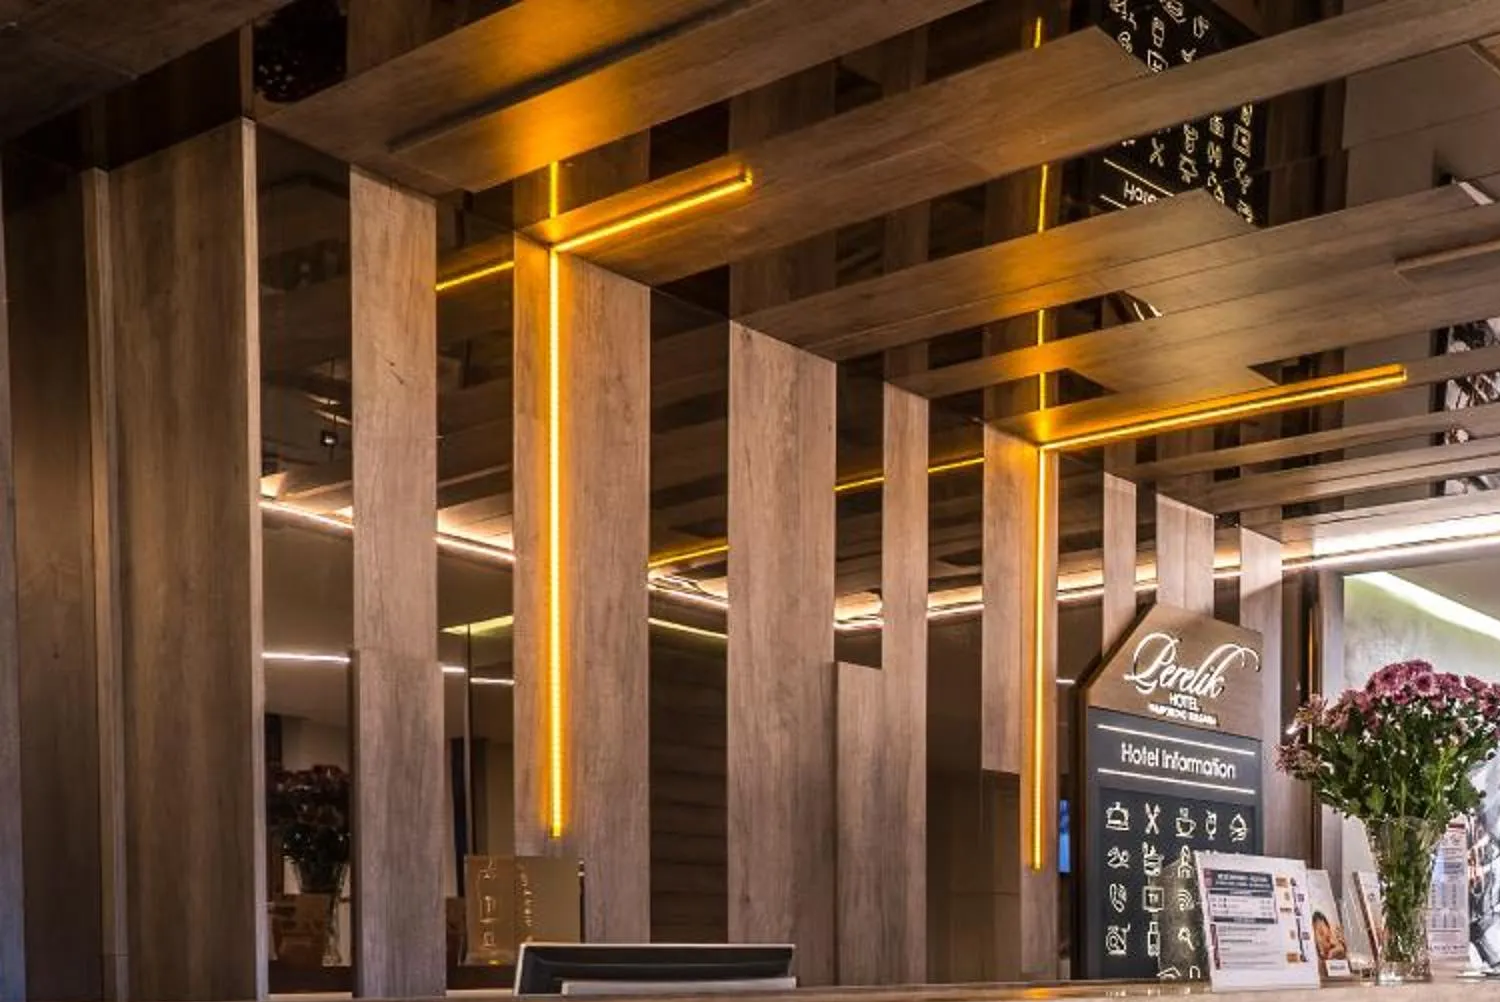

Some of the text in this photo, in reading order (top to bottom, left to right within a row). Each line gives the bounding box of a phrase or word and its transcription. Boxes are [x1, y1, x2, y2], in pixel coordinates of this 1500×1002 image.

[1123, 632, 1261, 698] Perelik
[1169, 692, 1200, 712] HOTEL
[1120, 742, 1236, 779] Hotel Information
